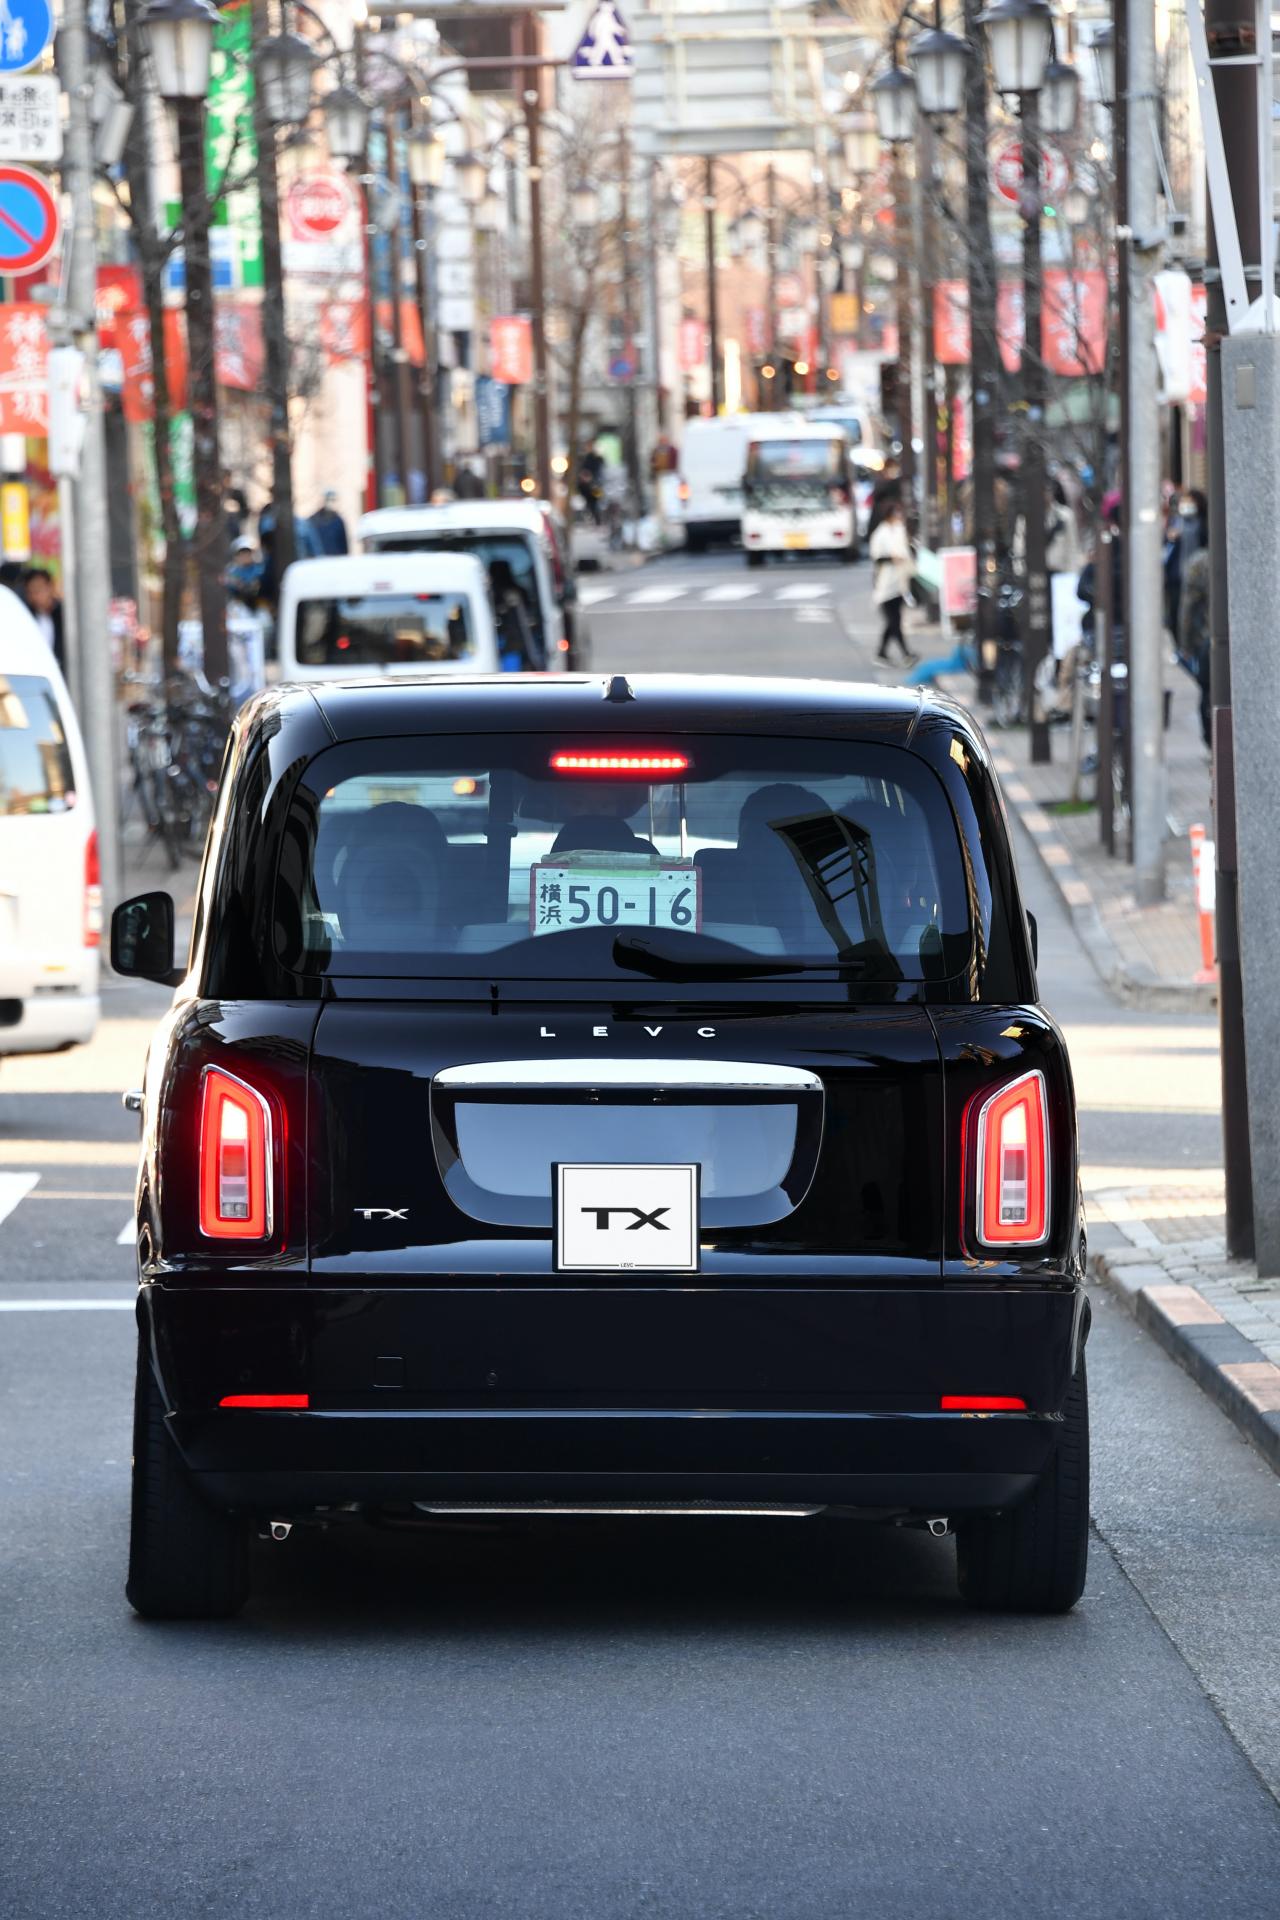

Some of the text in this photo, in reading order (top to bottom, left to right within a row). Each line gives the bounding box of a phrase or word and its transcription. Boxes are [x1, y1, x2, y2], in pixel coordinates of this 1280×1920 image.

[539, 884, 692, 926] 横浜 50-16
[540, 1026, 716, 1037] LEVC
[353, 1208, 410, 1220] TX
[581, 1207, 671, 1230] TX
